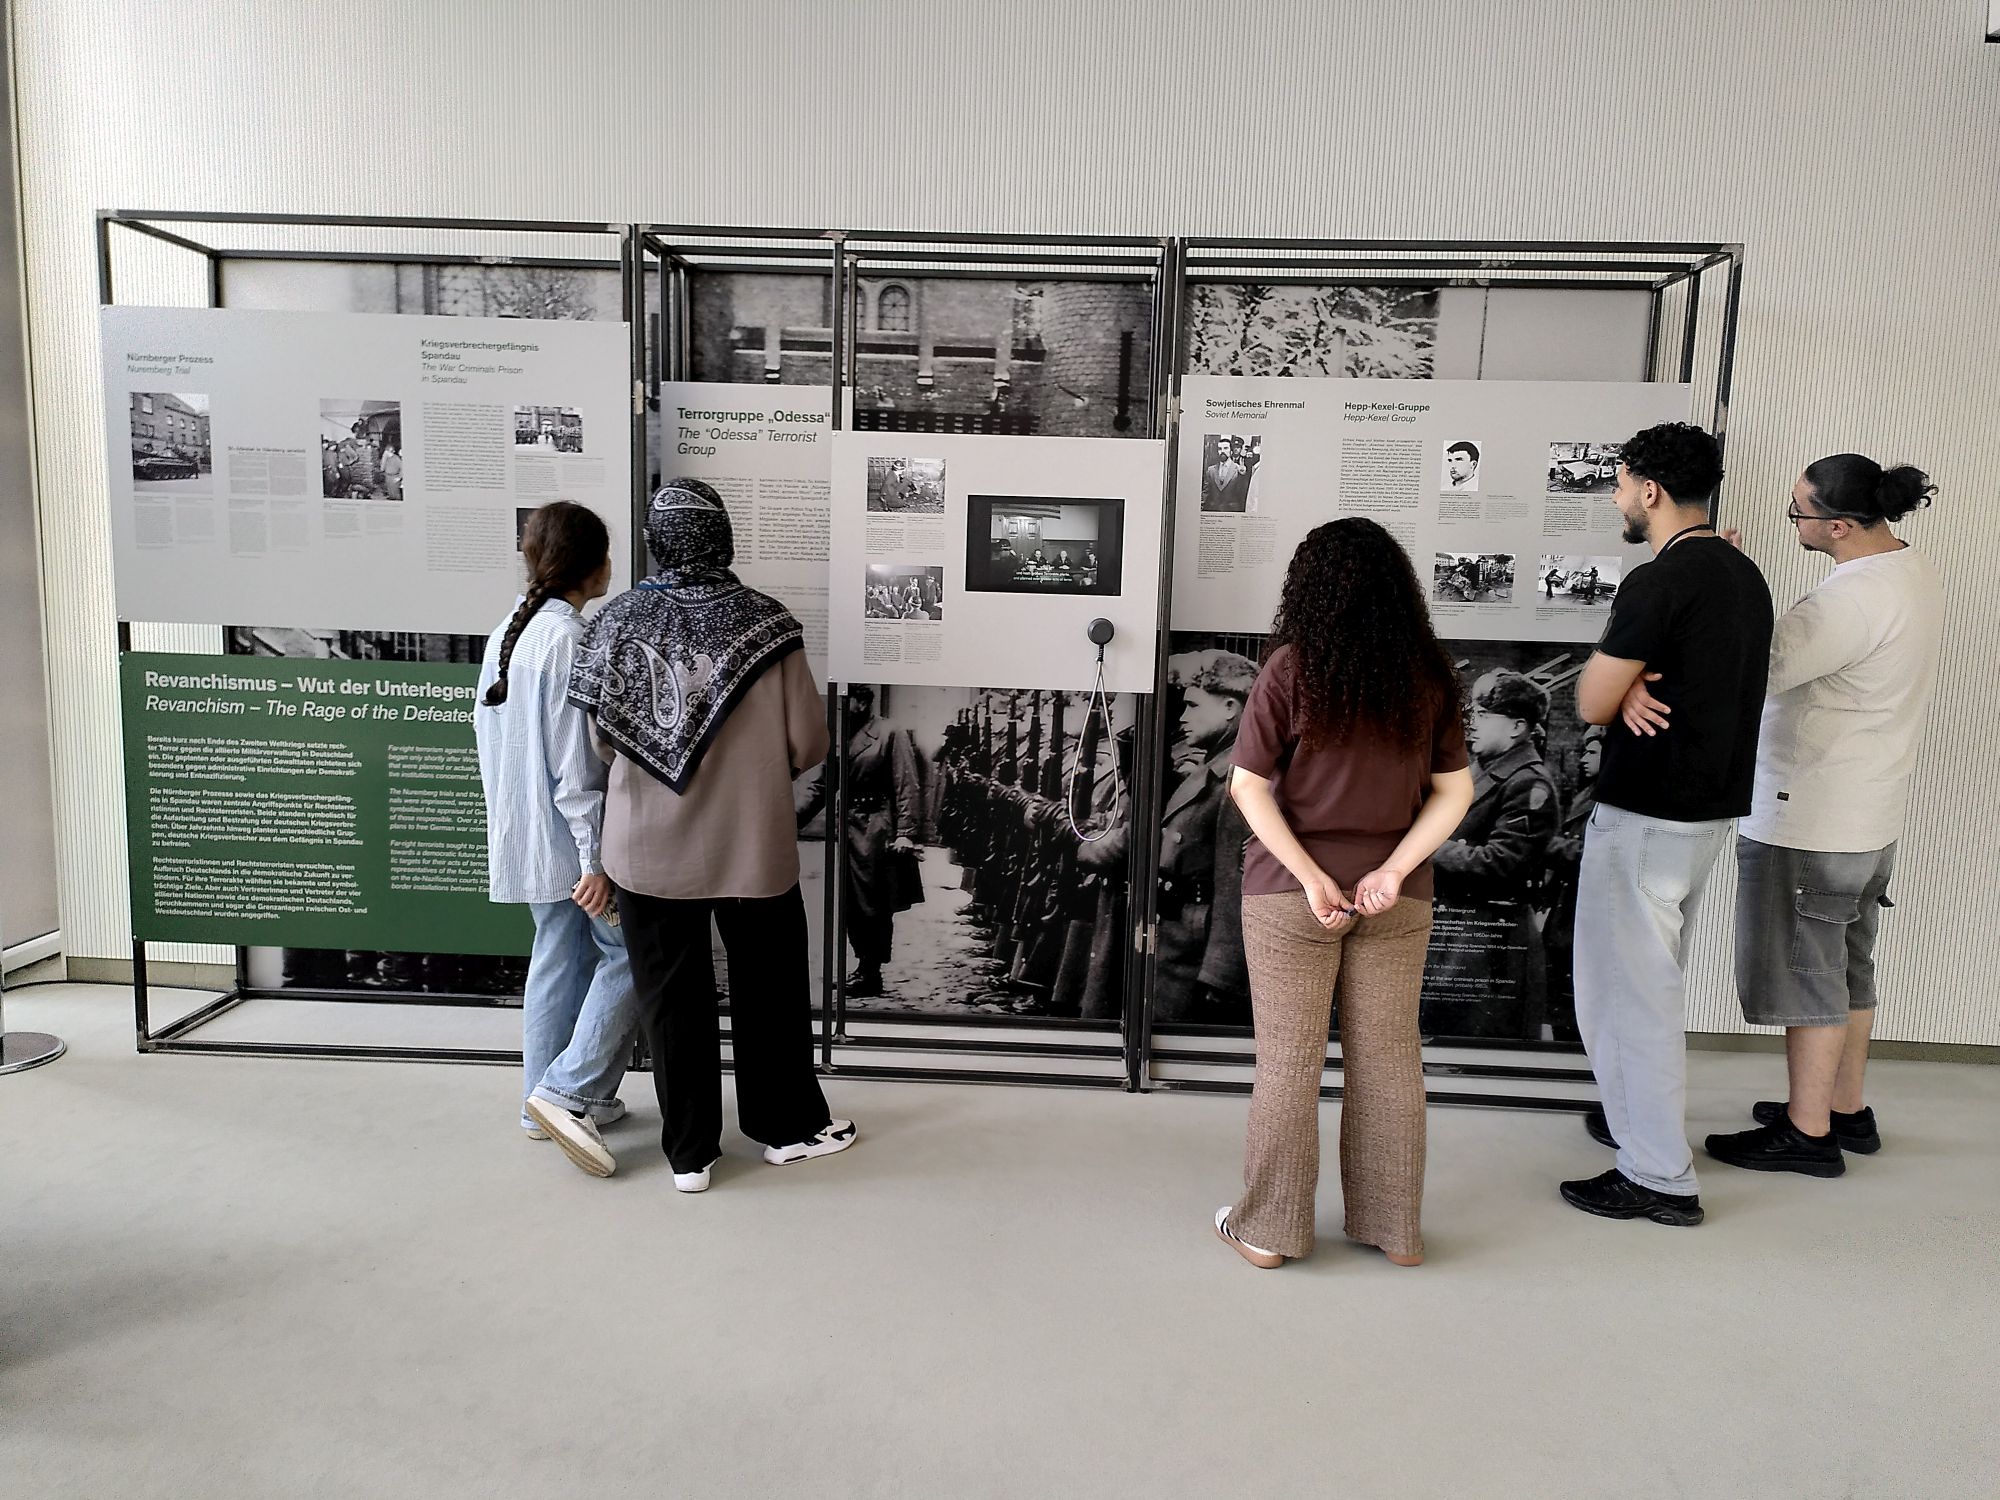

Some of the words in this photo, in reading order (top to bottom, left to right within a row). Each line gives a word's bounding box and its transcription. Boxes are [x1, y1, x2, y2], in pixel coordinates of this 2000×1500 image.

[421, 339, 539, 352] Kriegsverbrechergefängnis
[127, 353, 176, 364] Nürnberger
[179, 355, 214, 363] Prozess
[421, 351, 460, 360] Spandau
[128, 365, 172, 376] Nuremberg
[175, 366, 191, 374] Trial
[458, 364, 495, 373] Criminals
[498, 366, 523, 374] Prison
[431, 375, 467, 384] Spandau
[1206, 399, 1262, 408] Sowjetisches
[1344, 402, 1430, 412] Hepp-Kexel-Gruppe
[678, 408, 764, 423] Terrorgruppe
[768, 410, 830, 423] „Odessa“
[1205, 410, 1229, 418] Soviet
[1344, 413, 1389, 422] Hepp-Kexel
[1391, 414, 1416, 423] Group
[678, 427, 700, 439] The
[706, 428, 763, 441] “Odessa”
[768, 430, 817, 442] Terrorist
[678, 443, 716, 458] Group
[145, 671, 276, 691] Revanchismus
[297, 677, 334, 694] Wut
[340, 679, 370, 695] der
[146, 695, 245, 714] Revanchism
[267, 700, 297, 716] The
[302, 701, 345, 722] Rage
[351, 704, 369, 718] of
[372, 704, 398, 720] the
[170, 797, 199, 806] Spandau
[171, 822, 187, 830] Über
[252, 826, 278, 834] planten
[333, 838, 363, 846] Spandau
